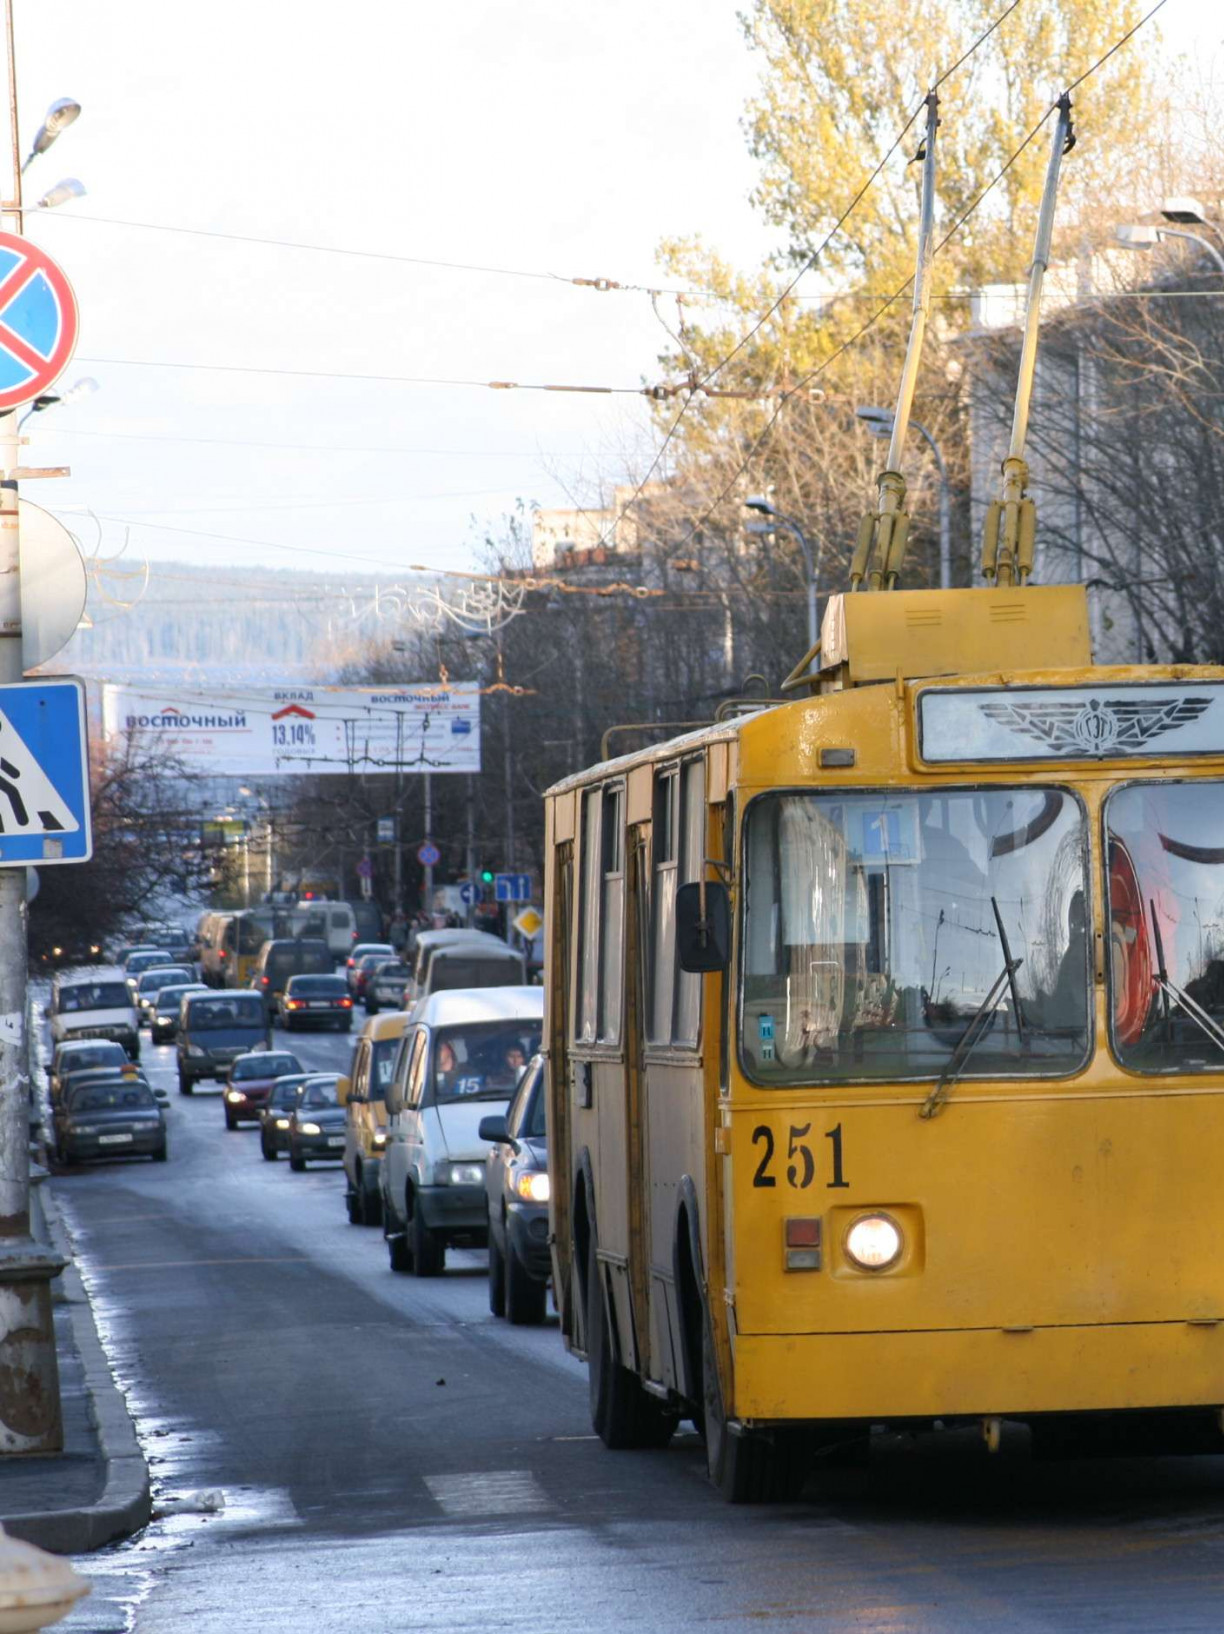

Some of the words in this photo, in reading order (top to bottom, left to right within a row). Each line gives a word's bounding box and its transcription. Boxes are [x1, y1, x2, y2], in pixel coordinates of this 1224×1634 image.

[274, 691, 314, 701] ВКЛАД
[126, 709, 246, 728] восточный
[458, 1078, 480, 1094] 15
[752, 1122, 849, 1189] 251
